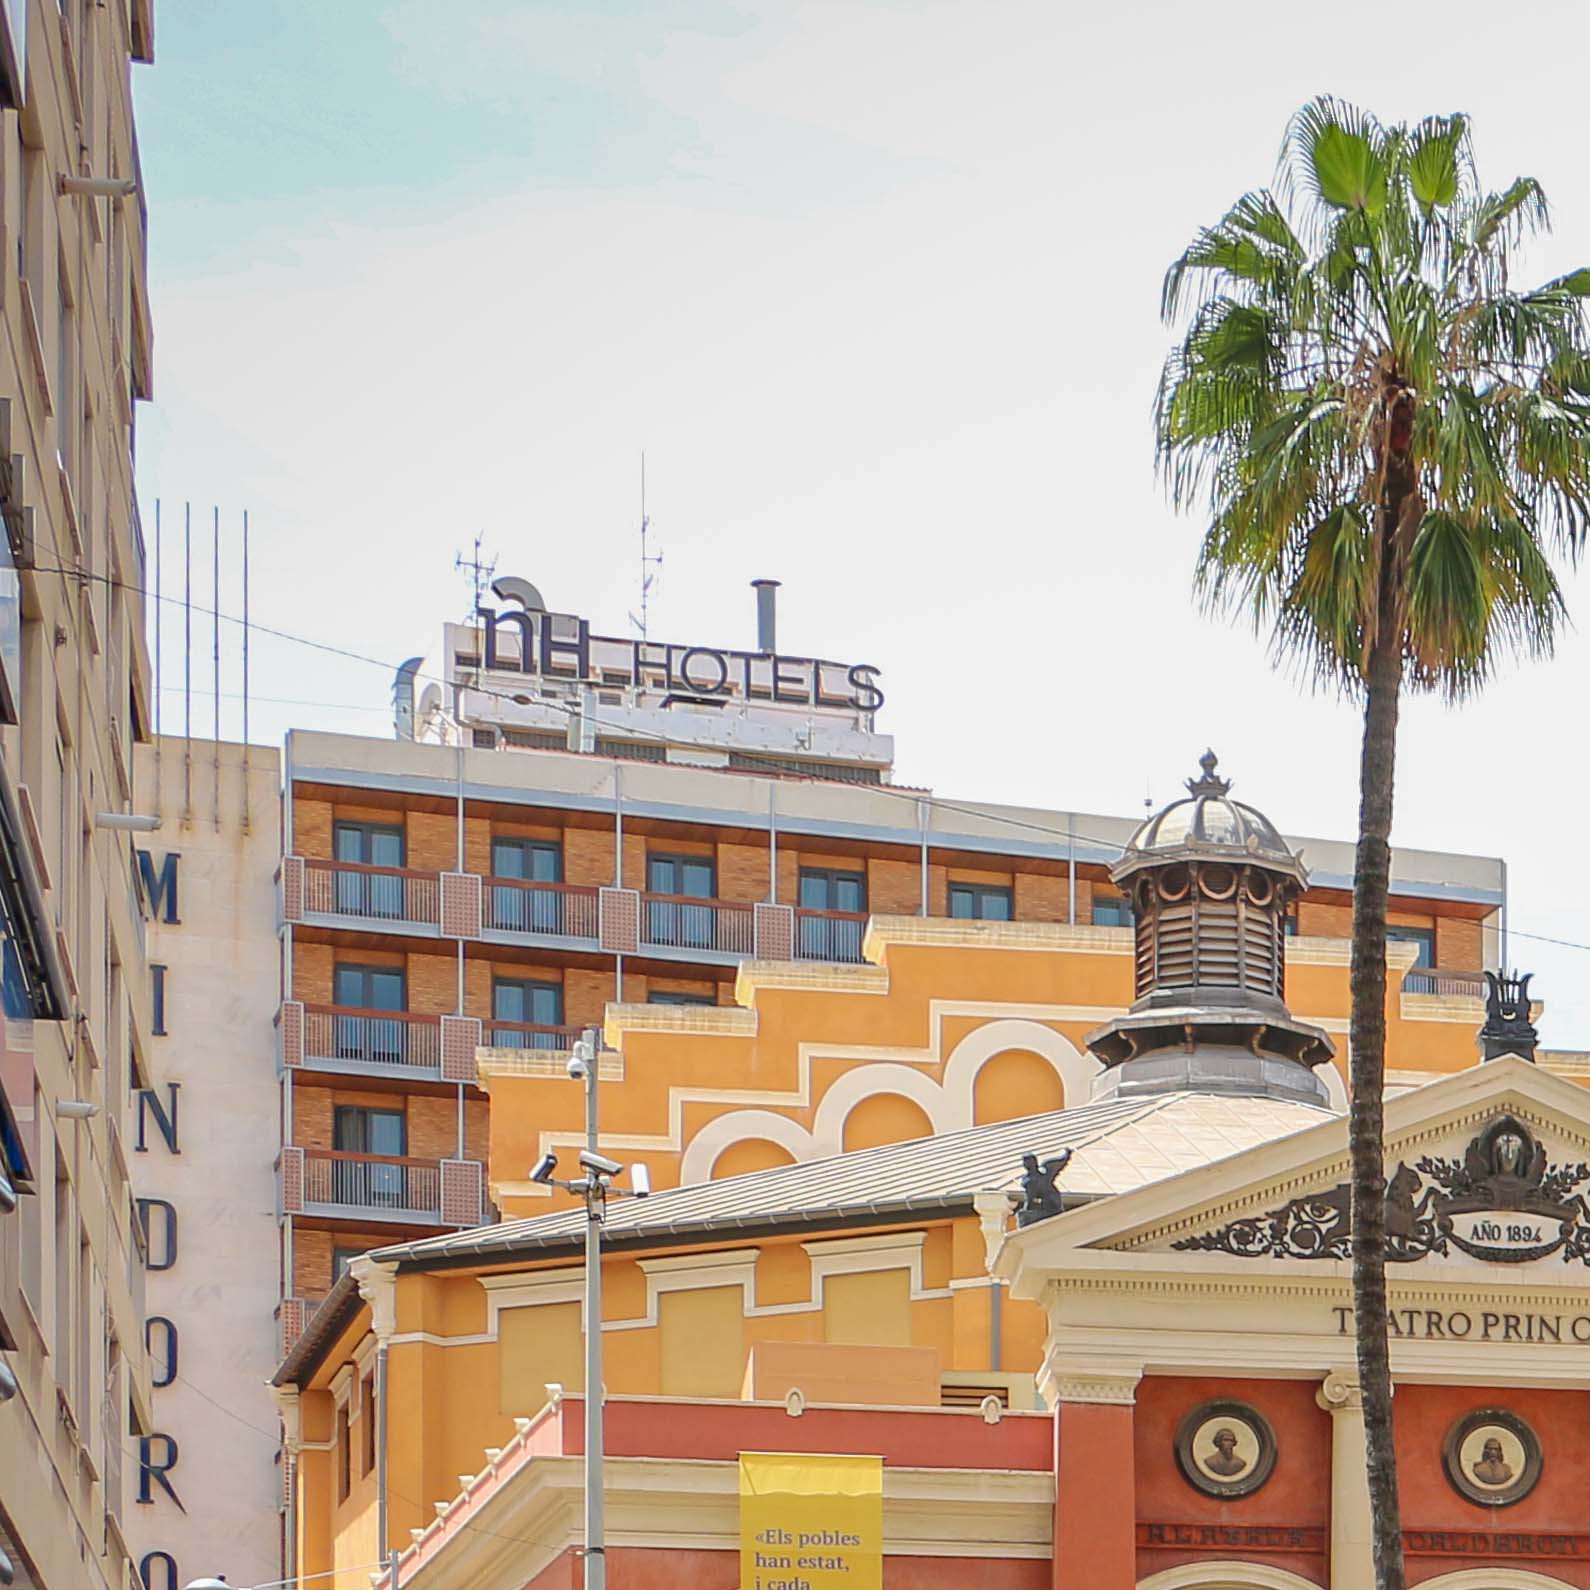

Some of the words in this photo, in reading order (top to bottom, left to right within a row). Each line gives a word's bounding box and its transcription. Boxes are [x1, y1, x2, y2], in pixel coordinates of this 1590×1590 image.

[633, 640, 885, 713] HOTELS
[1470, 1219, 1501, 1241] AÑO
[1506, 1224, 1543, 1243] 1894
[1332, 1307, 1472, 1337] TATRO
[799, 1530, 861, 1549] pobles
[755, 1552, 791, 1568] han
[797, 1555, 850, 1572] estat,
